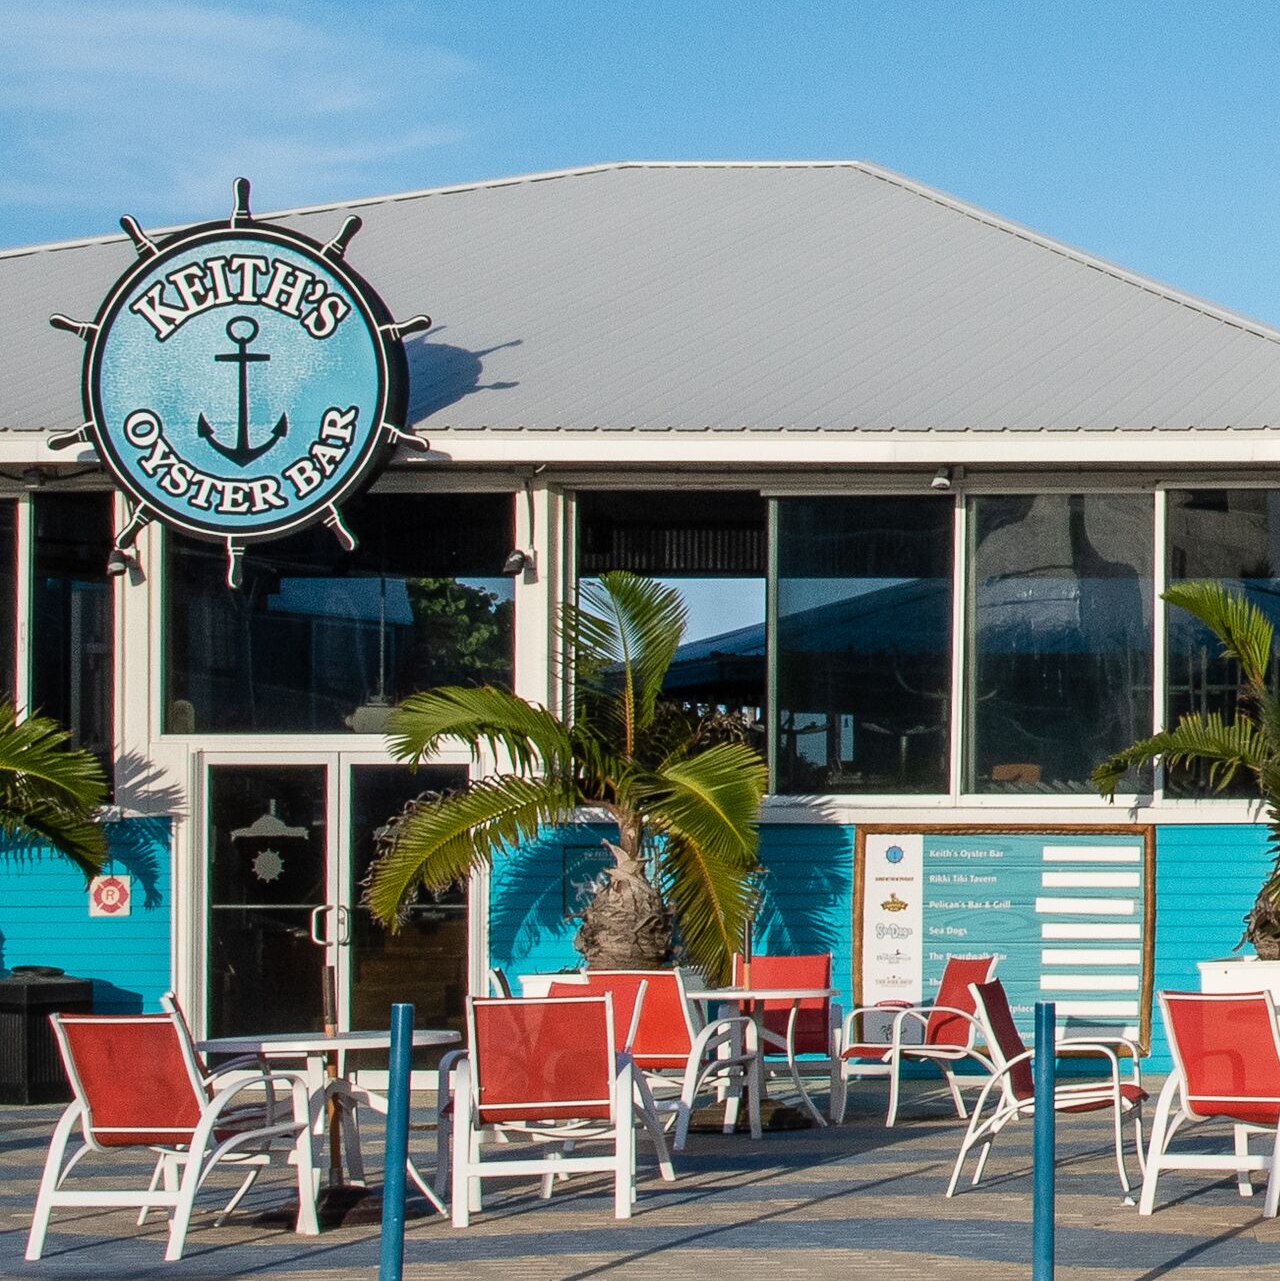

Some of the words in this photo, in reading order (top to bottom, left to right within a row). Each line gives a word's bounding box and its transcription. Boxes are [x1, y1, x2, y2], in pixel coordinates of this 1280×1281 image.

[132, 255, 349, 339] KEITH'S
[126, 410, 284, 514] OYSTER
[285, 407, 359, 499] BAR
[929, 849, 958, 857] Keith's
[960, 849, 987, 859] Oyster
[989, 849, 1003, 857] Bar
[970, 875, 997, 883] Tavern
[106, 889, 115, 901] R
[968, 900, 982, 908] Bar
[929, 927, 946, 935] Sea
[948, 927, 967, 936] Dogs
[929, 952, 944, 961] The
